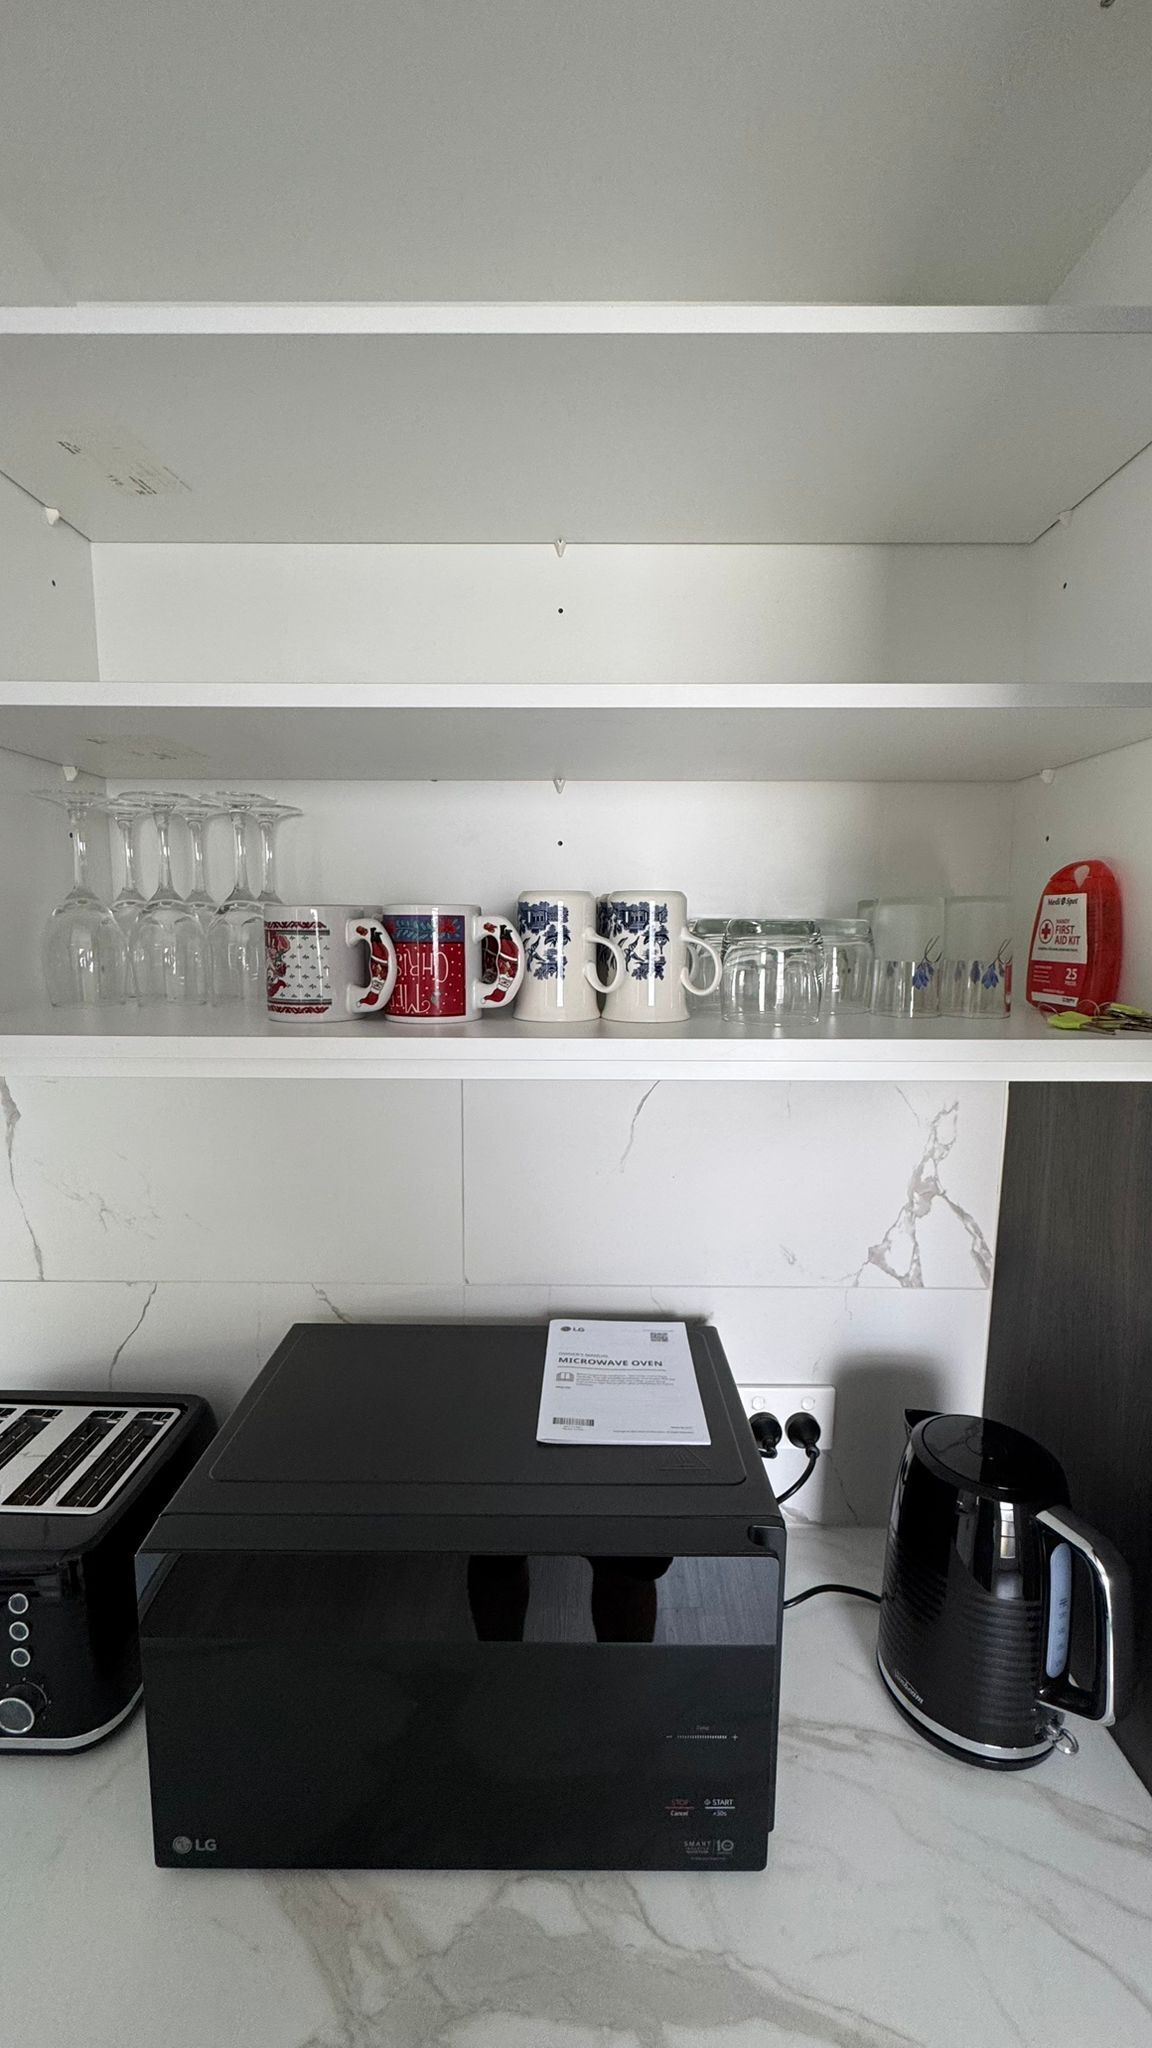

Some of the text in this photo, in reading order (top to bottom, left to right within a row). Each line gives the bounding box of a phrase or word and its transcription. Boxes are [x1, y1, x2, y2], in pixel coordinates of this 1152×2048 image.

[1055, 925, 1075, 934] FIRST
[1054, 935, 1081, 945] AID KIT
[1065, 968, 1078, 980] 25
[558, 1357, 628, 1367] MICROWAVE
[195, 1838, 216, 1851] LG
